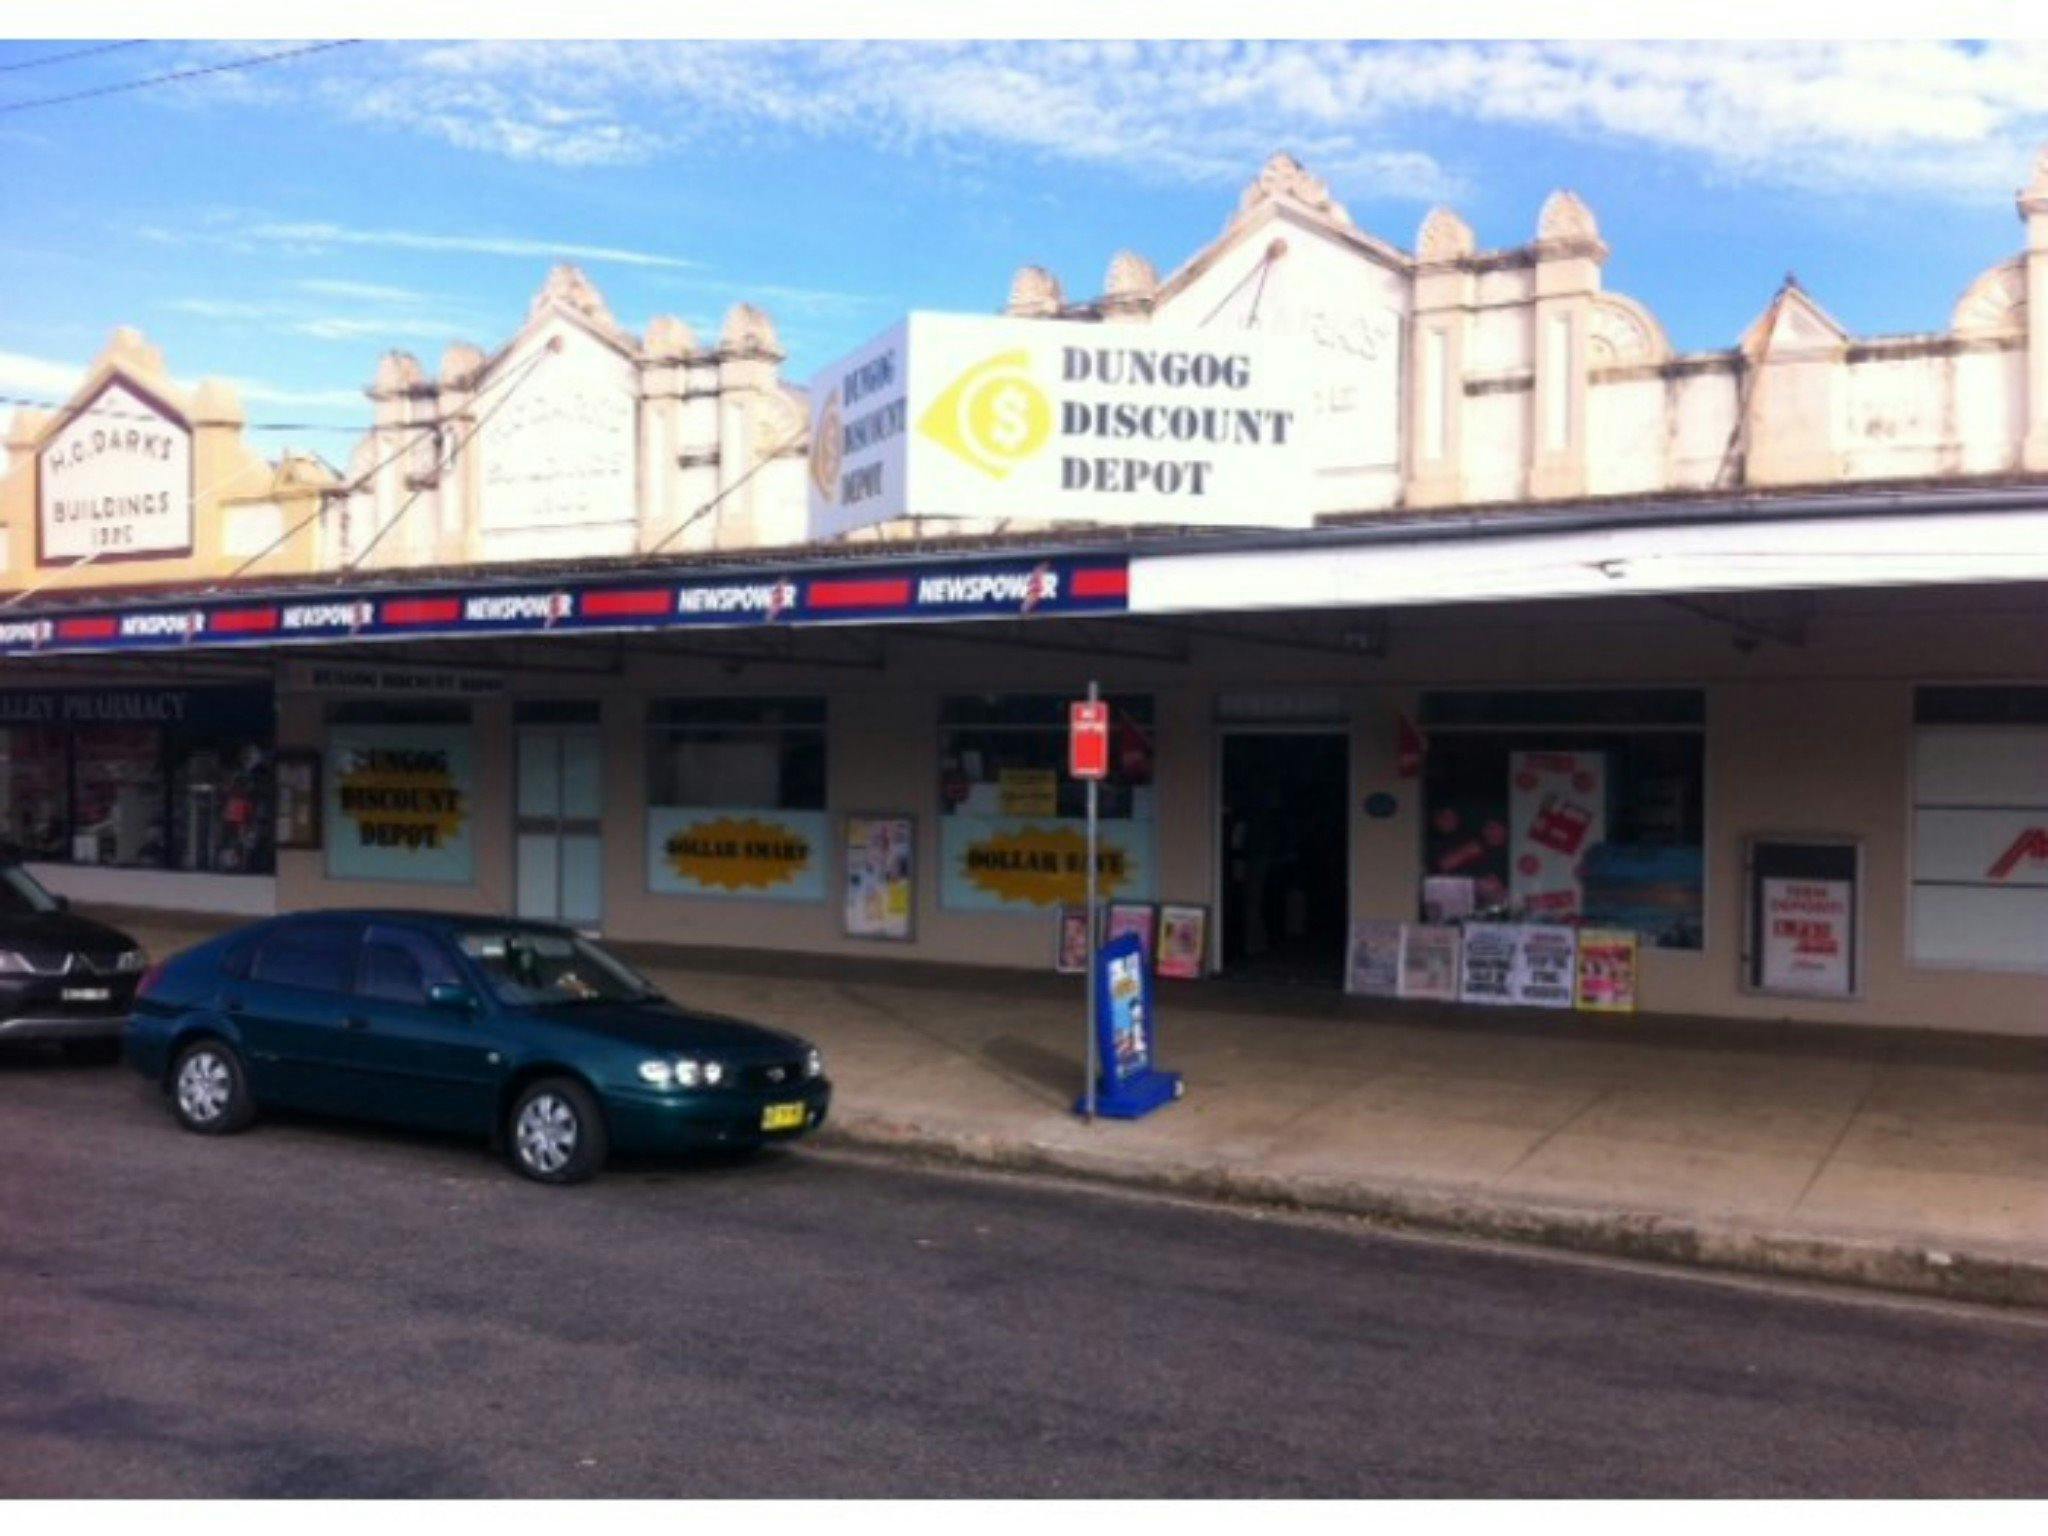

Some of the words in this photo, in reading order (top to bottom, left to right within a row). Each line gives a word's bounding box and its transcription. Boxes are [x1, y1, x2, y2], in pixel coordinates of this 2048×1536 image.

[1061, 346, 1251, 389] DUNGOG
[1060, 401, 1294, 444] DISCOUNT
[842, 460, 883, 505] DEPOT
[1060, 457, 1213, 495] DEPOT
[341, 785, 461, 811] DISCOUNT
[360, 820, 439, 848] DEPOT
[968, 847, 1058, 874] DOLLAR
